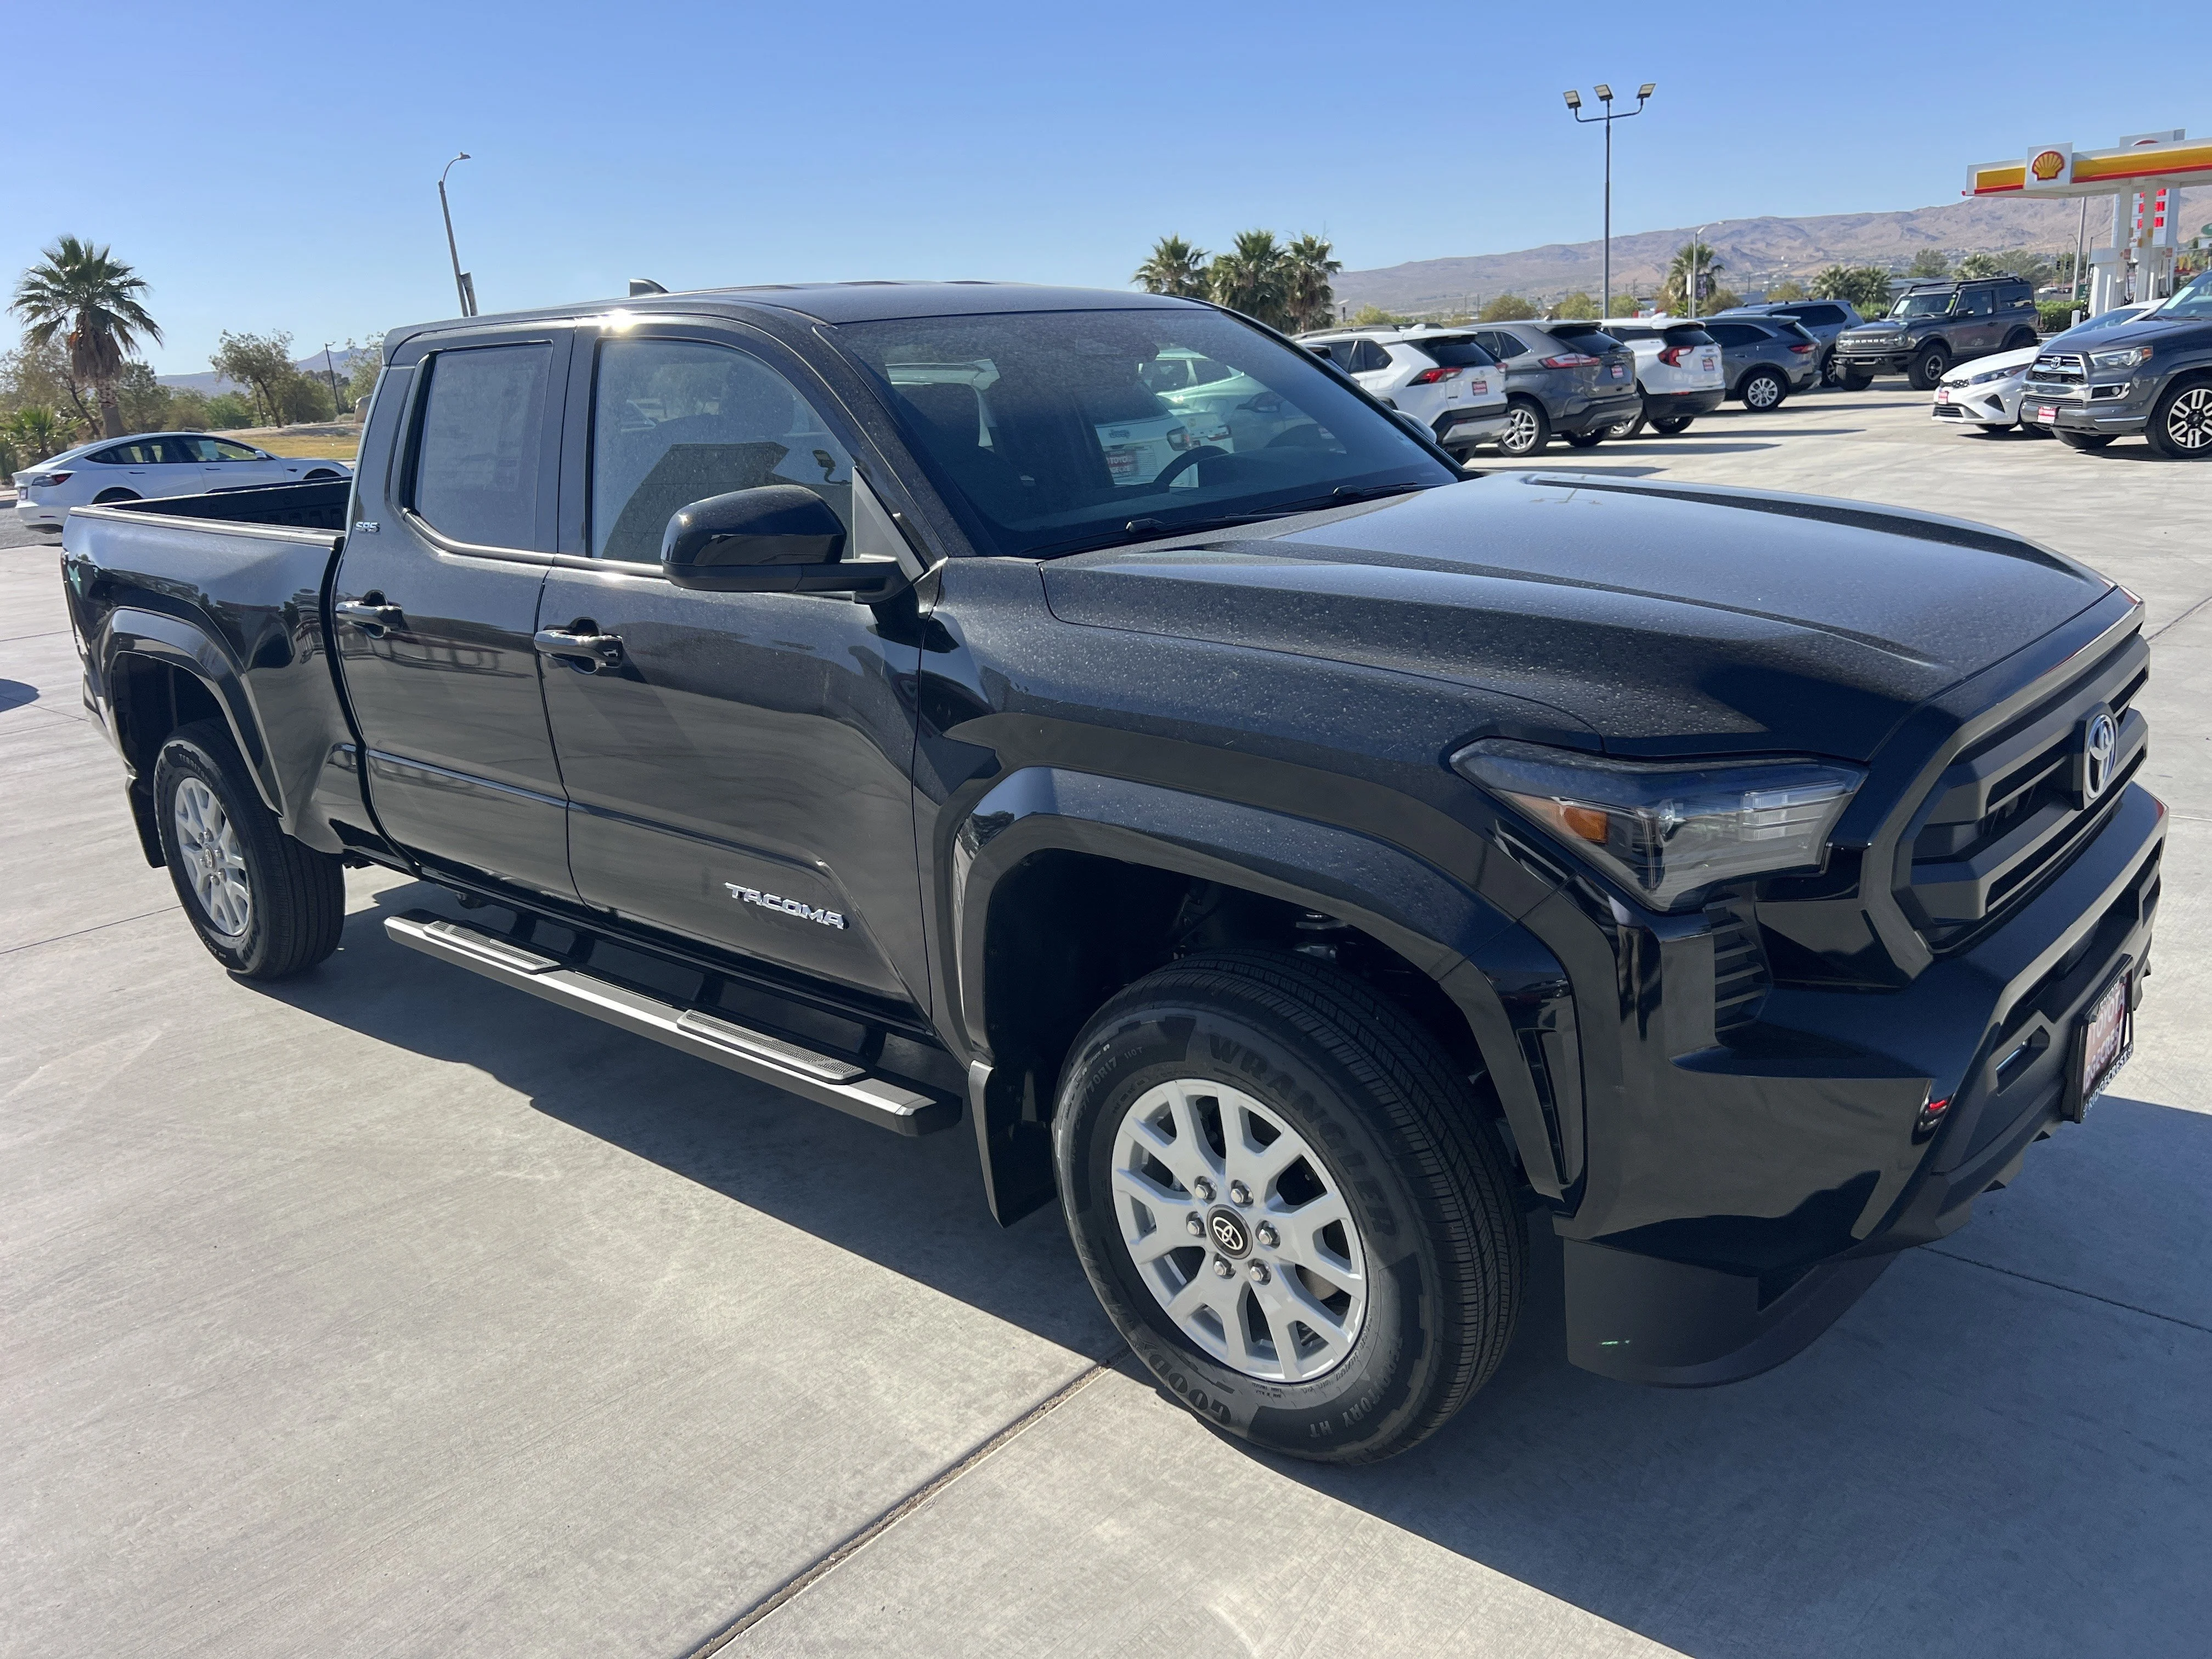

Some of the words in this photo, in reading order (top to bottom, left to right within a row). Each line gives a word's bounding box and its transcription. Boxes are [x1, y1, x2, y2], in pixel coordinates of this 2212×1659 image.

[356, 521, 379, 533] SR5
[724, 882, 844, 930] TACOMA
[2088, 1050, 2128, 1110] RIDGECREST
[1209, 1032, 1400, 1238] WRANGLER
